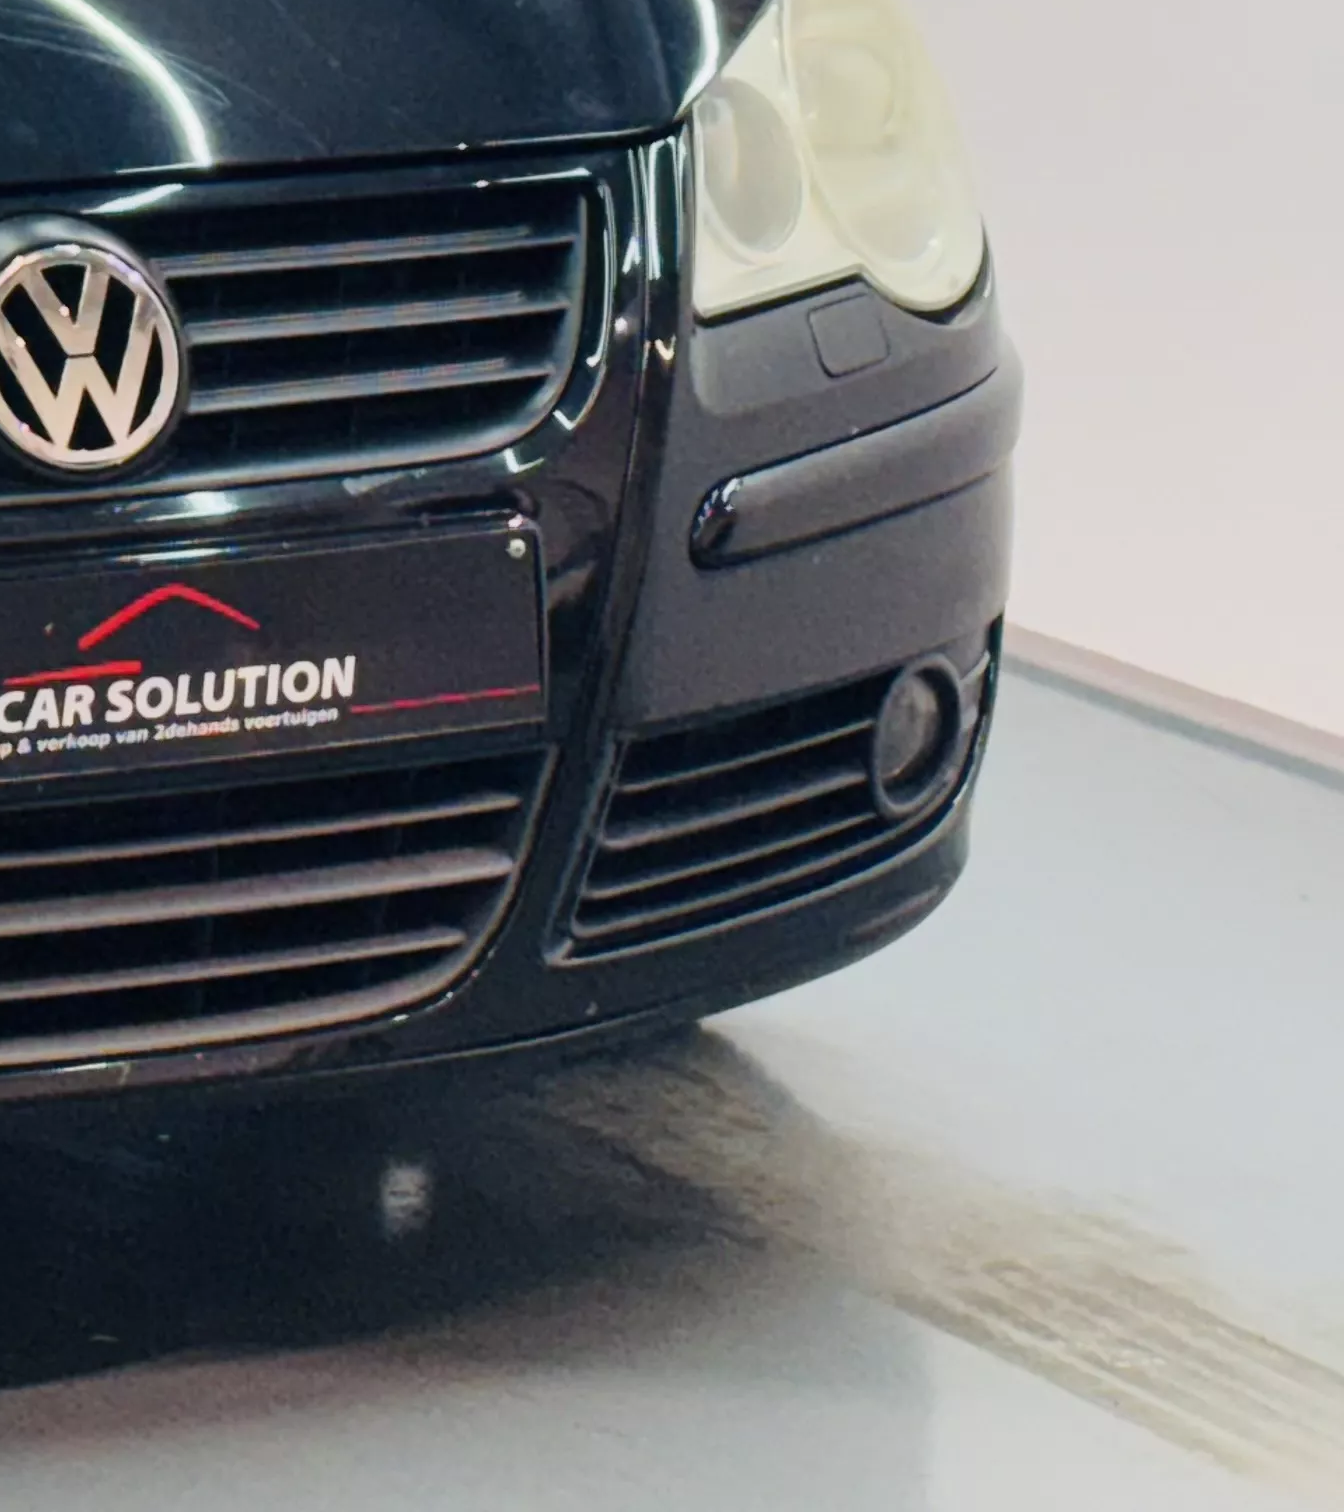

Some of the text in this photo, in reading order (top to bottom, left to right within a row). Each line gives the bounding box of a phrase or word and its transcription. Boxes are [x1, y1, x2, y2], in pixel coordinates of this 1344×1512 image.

[104, 655, 357, 724] SOLUTION
[16, 737, 33, 756] &
[36, 730, 111, 754] verkoop
[115, 725, 149, 744] van
[153, 716, 241, 742] 2dehands
[244, 707, 339, 732] voertuigen
